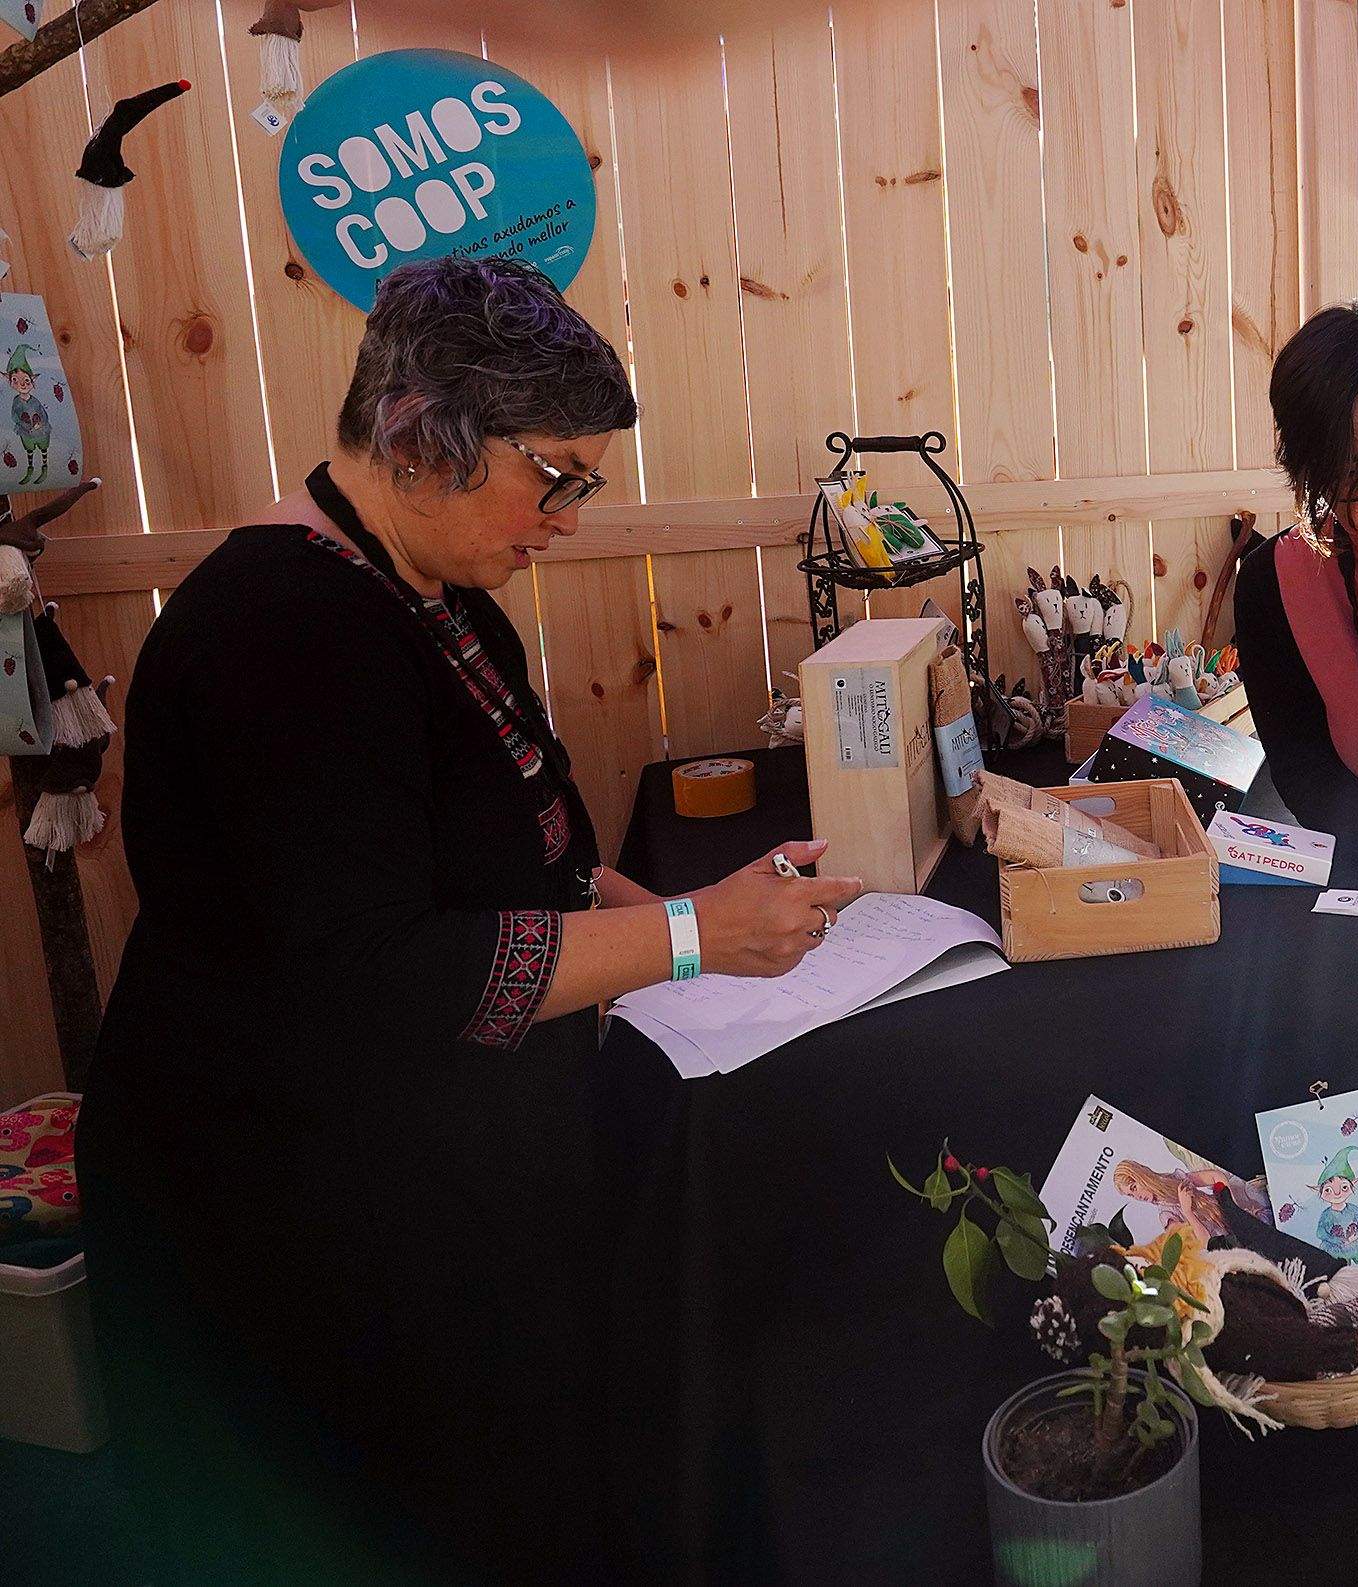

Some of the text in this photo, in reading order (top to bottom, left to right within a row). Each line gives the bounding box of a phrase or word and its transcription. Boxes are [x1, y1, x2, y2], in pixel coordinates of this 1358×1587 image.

[298, 81, 521, 209] SOMOS
[335, 162, 496, 269] COOP
[493, 204, 561, 243] axudamos
[566, 199, 576, 209] a
[528, 220, 570, 247] mellor
[875, 681, 891, 755] MITOGALI
[1228, 846, 1304, 873] GATIPEDRO
